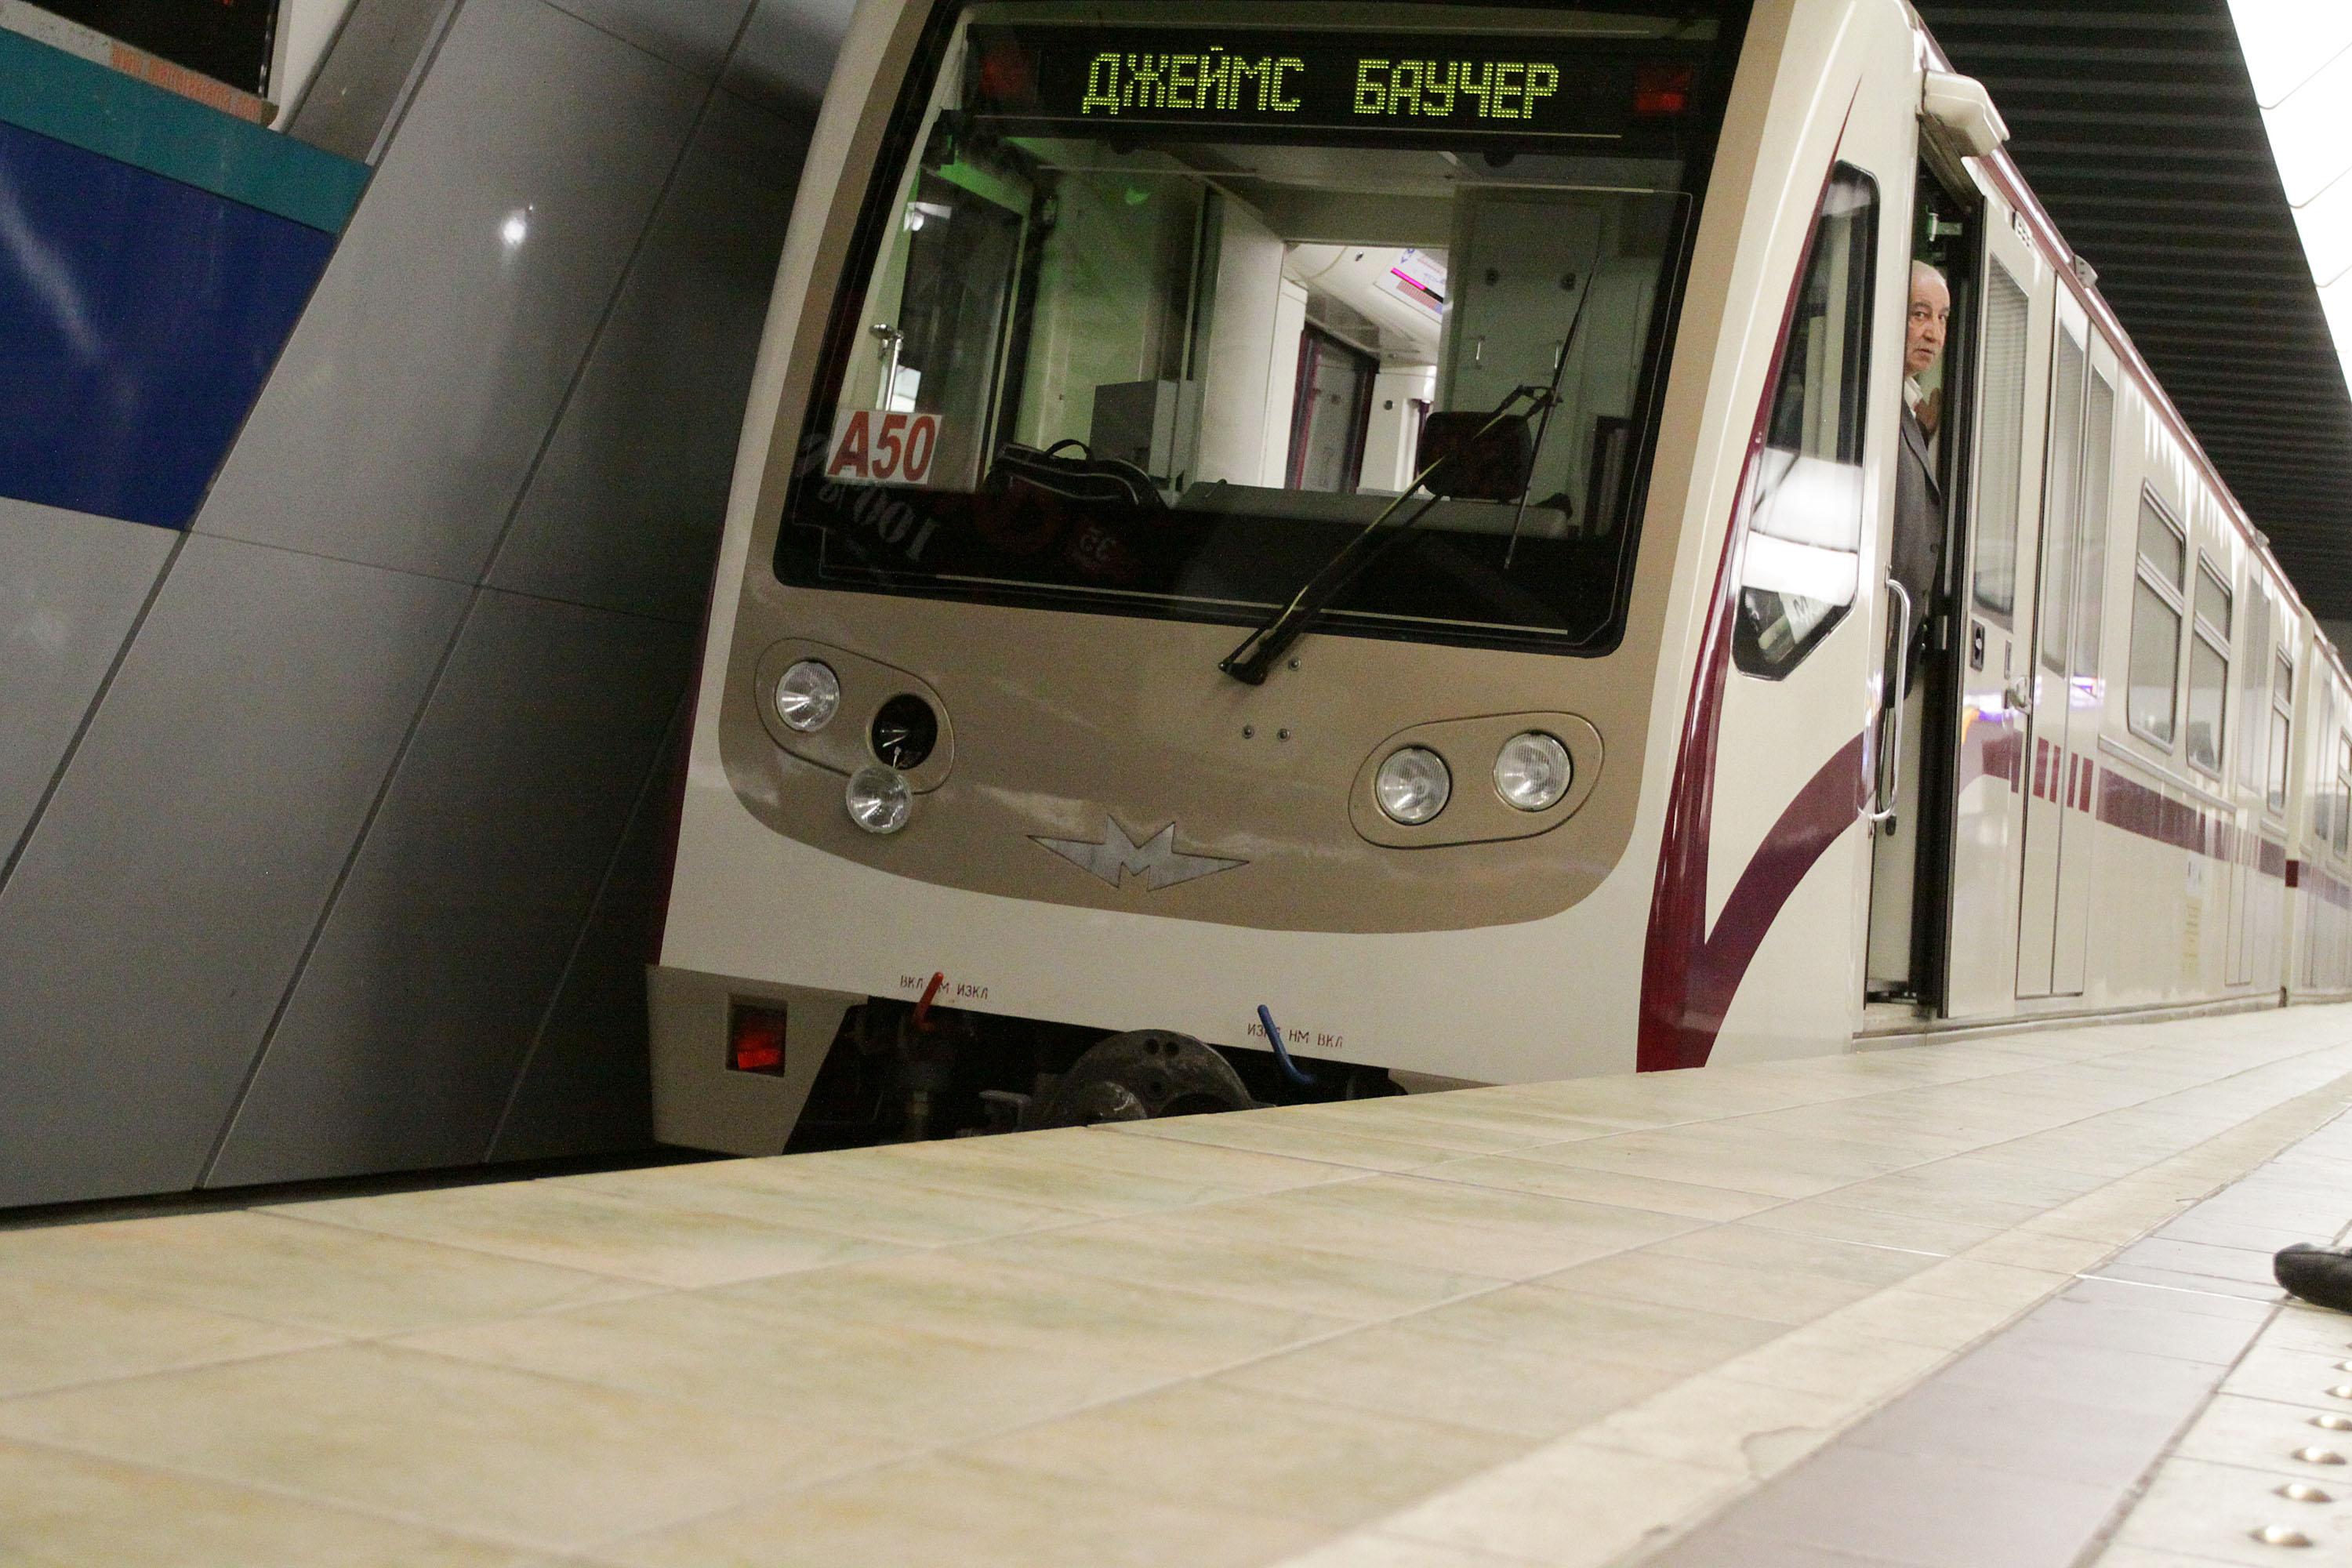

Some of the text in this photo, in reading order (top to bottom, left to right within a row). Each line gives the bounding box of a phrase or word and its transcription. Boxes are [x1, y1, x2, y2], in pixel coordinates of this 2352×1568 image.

[1082, 46, 1559, 118] ДЖЕЙМС БАУЧЕР
[900, 975, 924, 989] ВКЛ
[956, 982, 989, 1000] ИЗКЛ
[1289, 1029, 1310, 1044] НМ
[1317, 1033, 1343, 1048] ВКЛ
